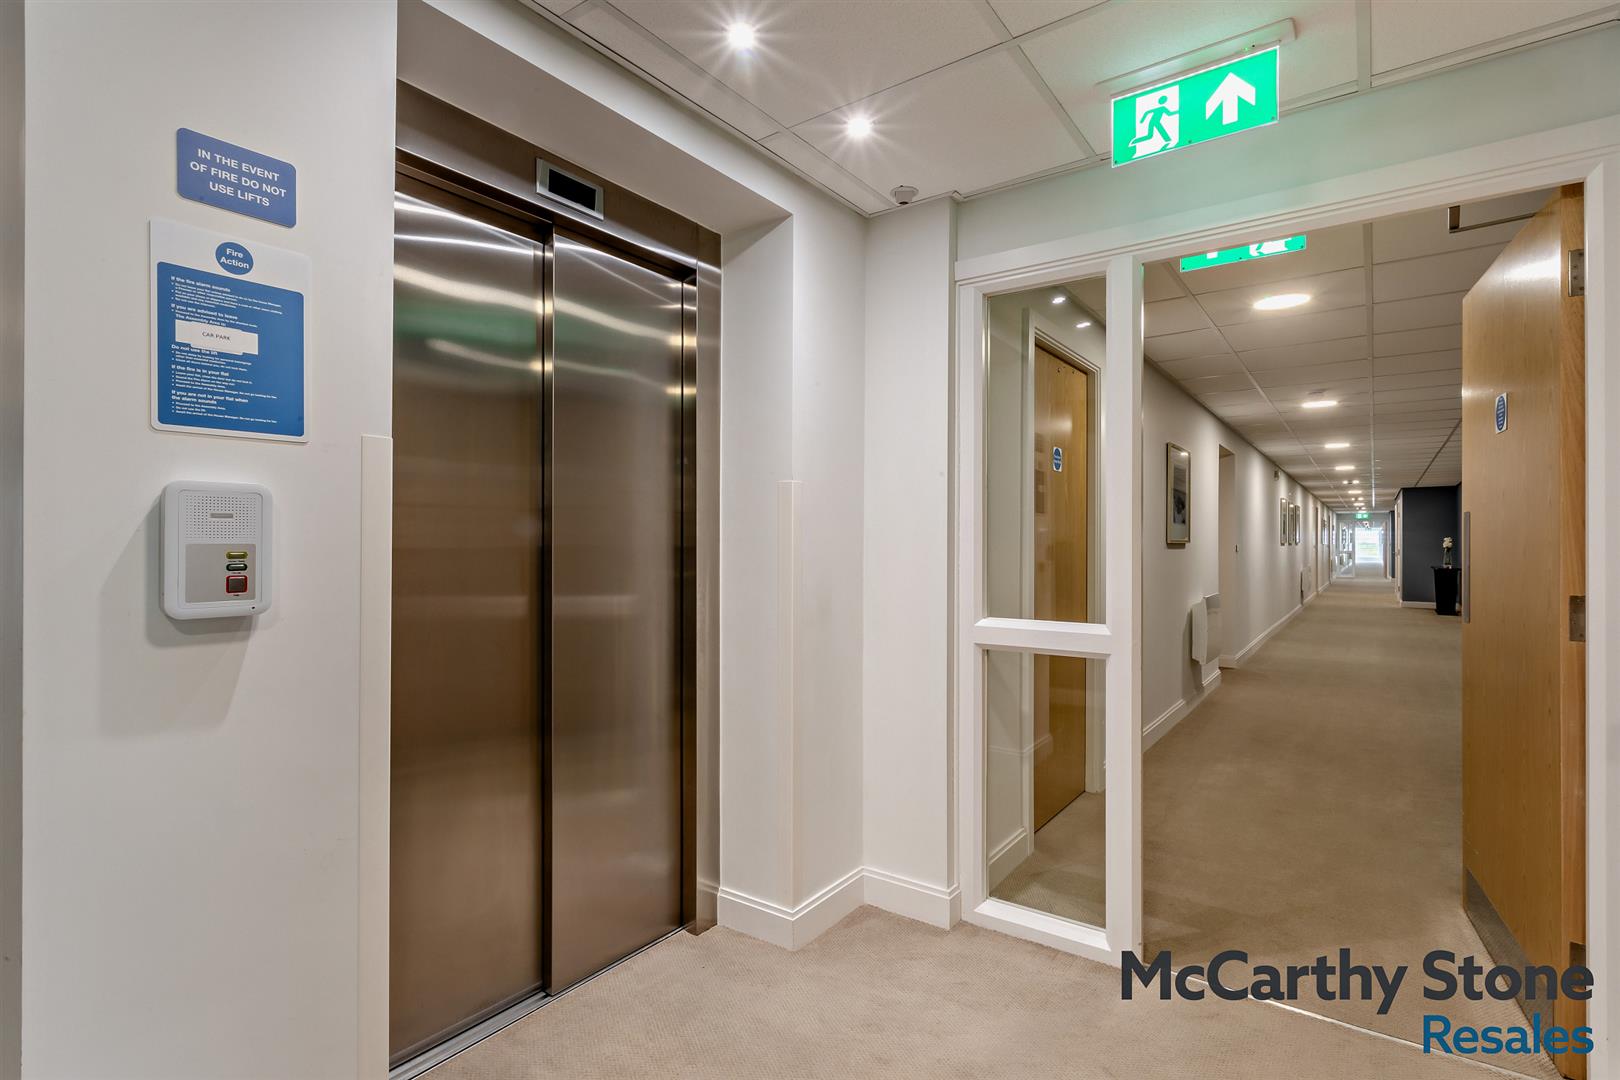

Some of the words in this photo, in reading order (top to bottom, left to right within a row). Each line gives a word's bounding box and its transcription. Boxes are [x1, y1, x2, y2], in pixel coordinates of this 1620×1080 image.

[198, 148, 211, 160] IN
[214, 153, 239, 169] THE
[242, 162, 280, 182] EVENT
[190, 161, 207, 173] OF
[211, 167, 238, 184] FIRE
[242, 176, 260, 190] DO
[262, 183, 287, 198] NOT
[209, 181, 234, 197] USE
[238, 189, 270, 207] LIFTS
[220, 256, 250, 270] Action
[226, 248, 244, 259] Fire
